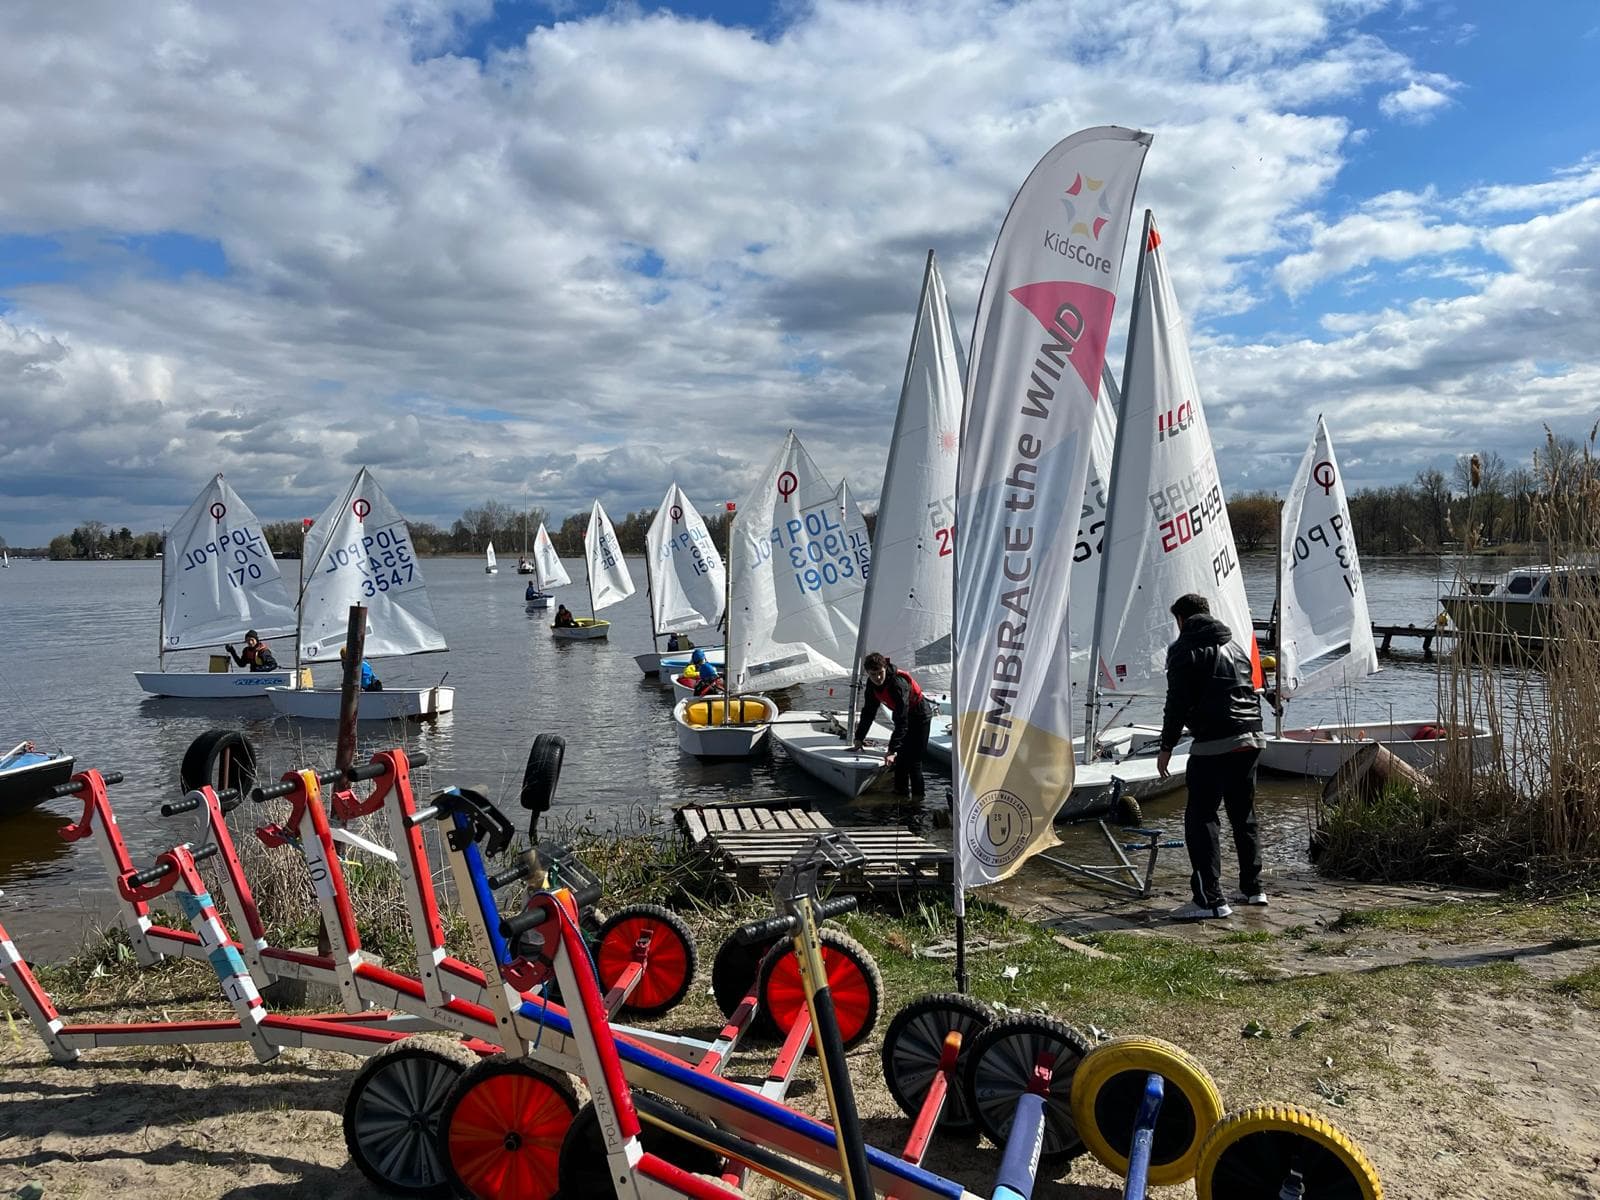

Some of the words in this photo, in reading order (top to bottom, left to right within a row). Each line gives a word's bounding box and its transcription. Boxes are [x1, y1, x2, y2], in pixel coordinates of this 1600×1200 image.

[1044, 229, 1111, 274] KidsCore
[1020, 302, 1086, 420] WIND
[1158, 400, 1195, 443] ILCA
[1005, 433, 1042, 513] the
[786, 509, 840, 544] POL
[1159, 484, 1222, 553] 206499
[219, 527, 260, 553] POL
[361, 528, 406, 555] POL
[679, 526, 707, 548] POL
[228, 563, 261, 588] 170
[361, 563, 413, 597] 3547
[693, 556, 715, 576] 156
[796, 556, 854, 595] 1903
[1212, 545, 1236, 587] POL
[976, 526, 1033, 758] EMBRACE
[309, 855, 327, 882] 10
[229, 983, 243, 1001] 1
[604, 1119, 618, 1149] POL
